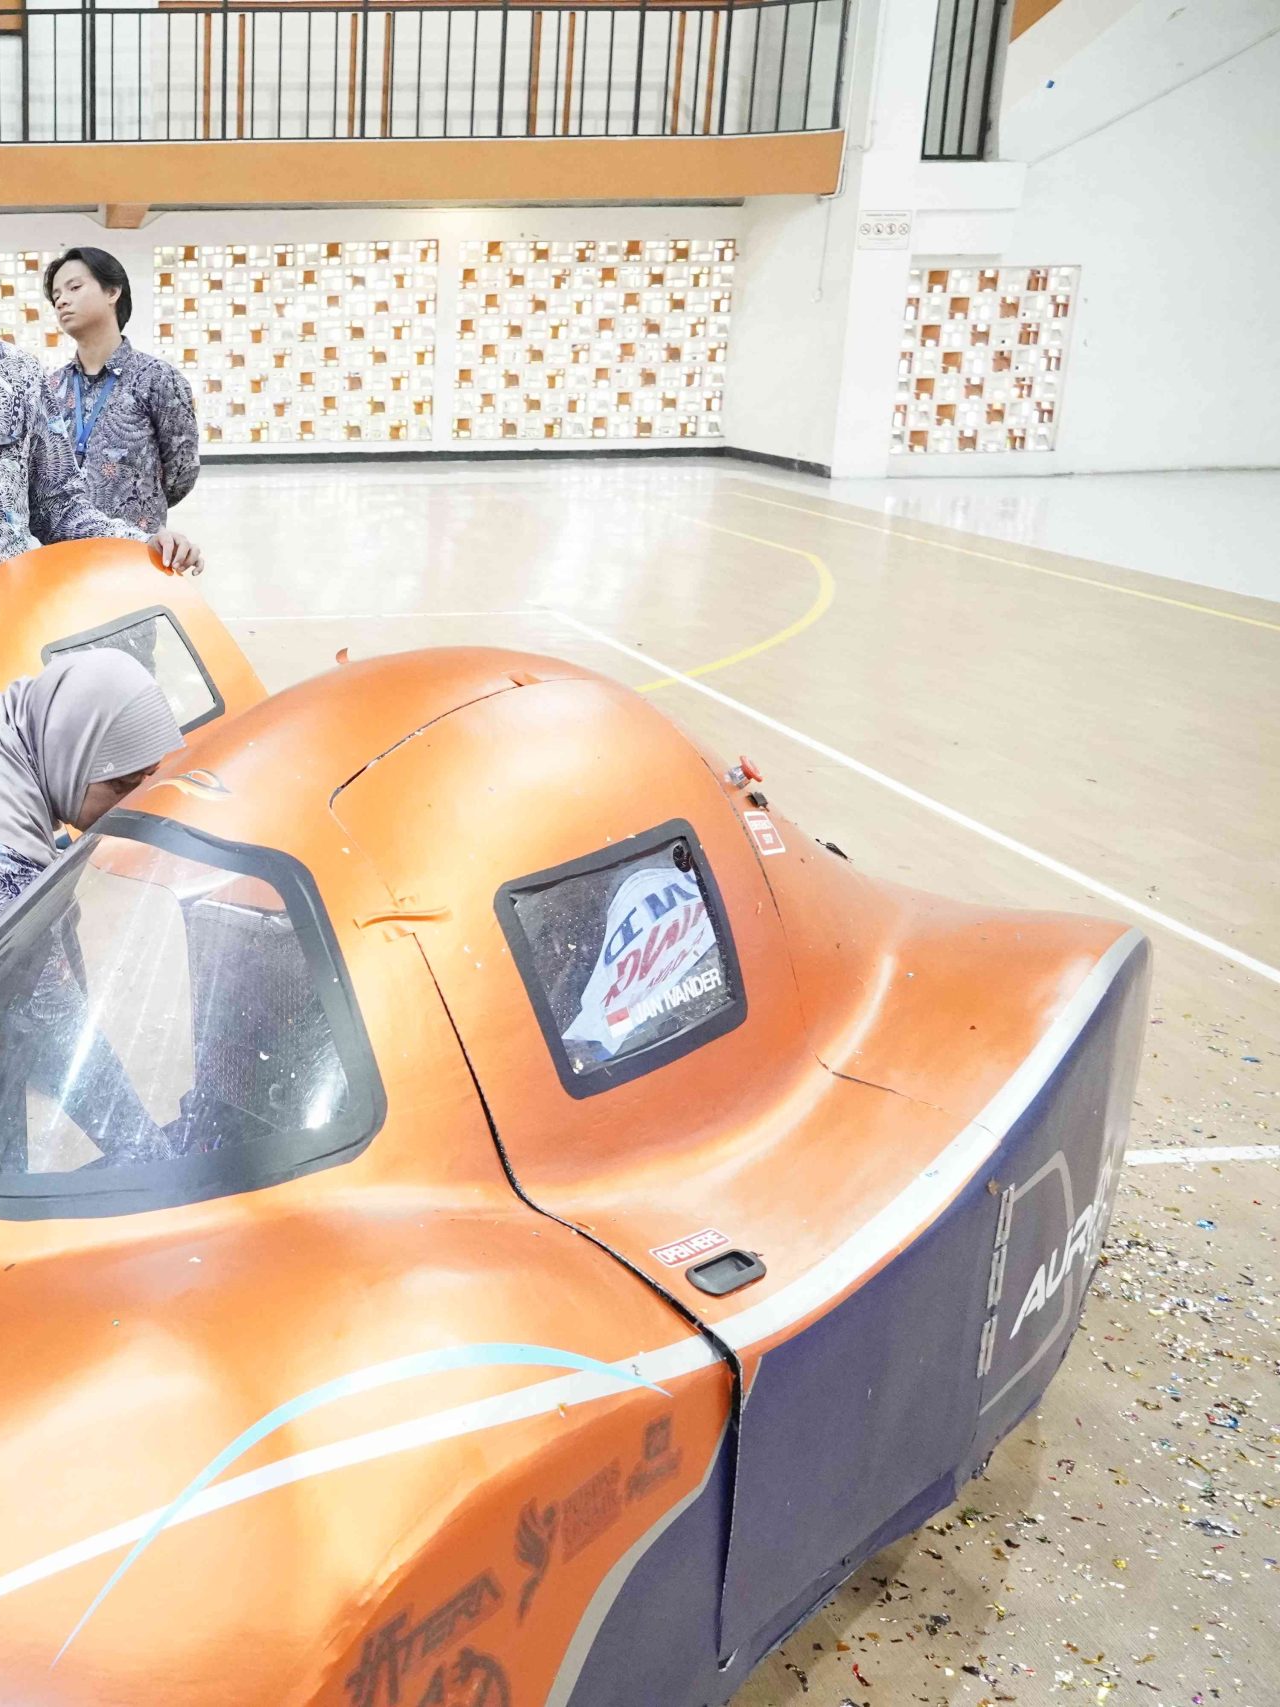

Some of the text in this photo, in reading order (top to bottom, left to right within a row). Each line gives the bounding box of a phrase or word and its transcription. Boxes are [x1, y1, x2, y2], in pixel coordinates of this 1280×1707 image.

[663, 968, 723, 1010] IVANDER
[656, 1230, 726, 1263] OPEN HERE
